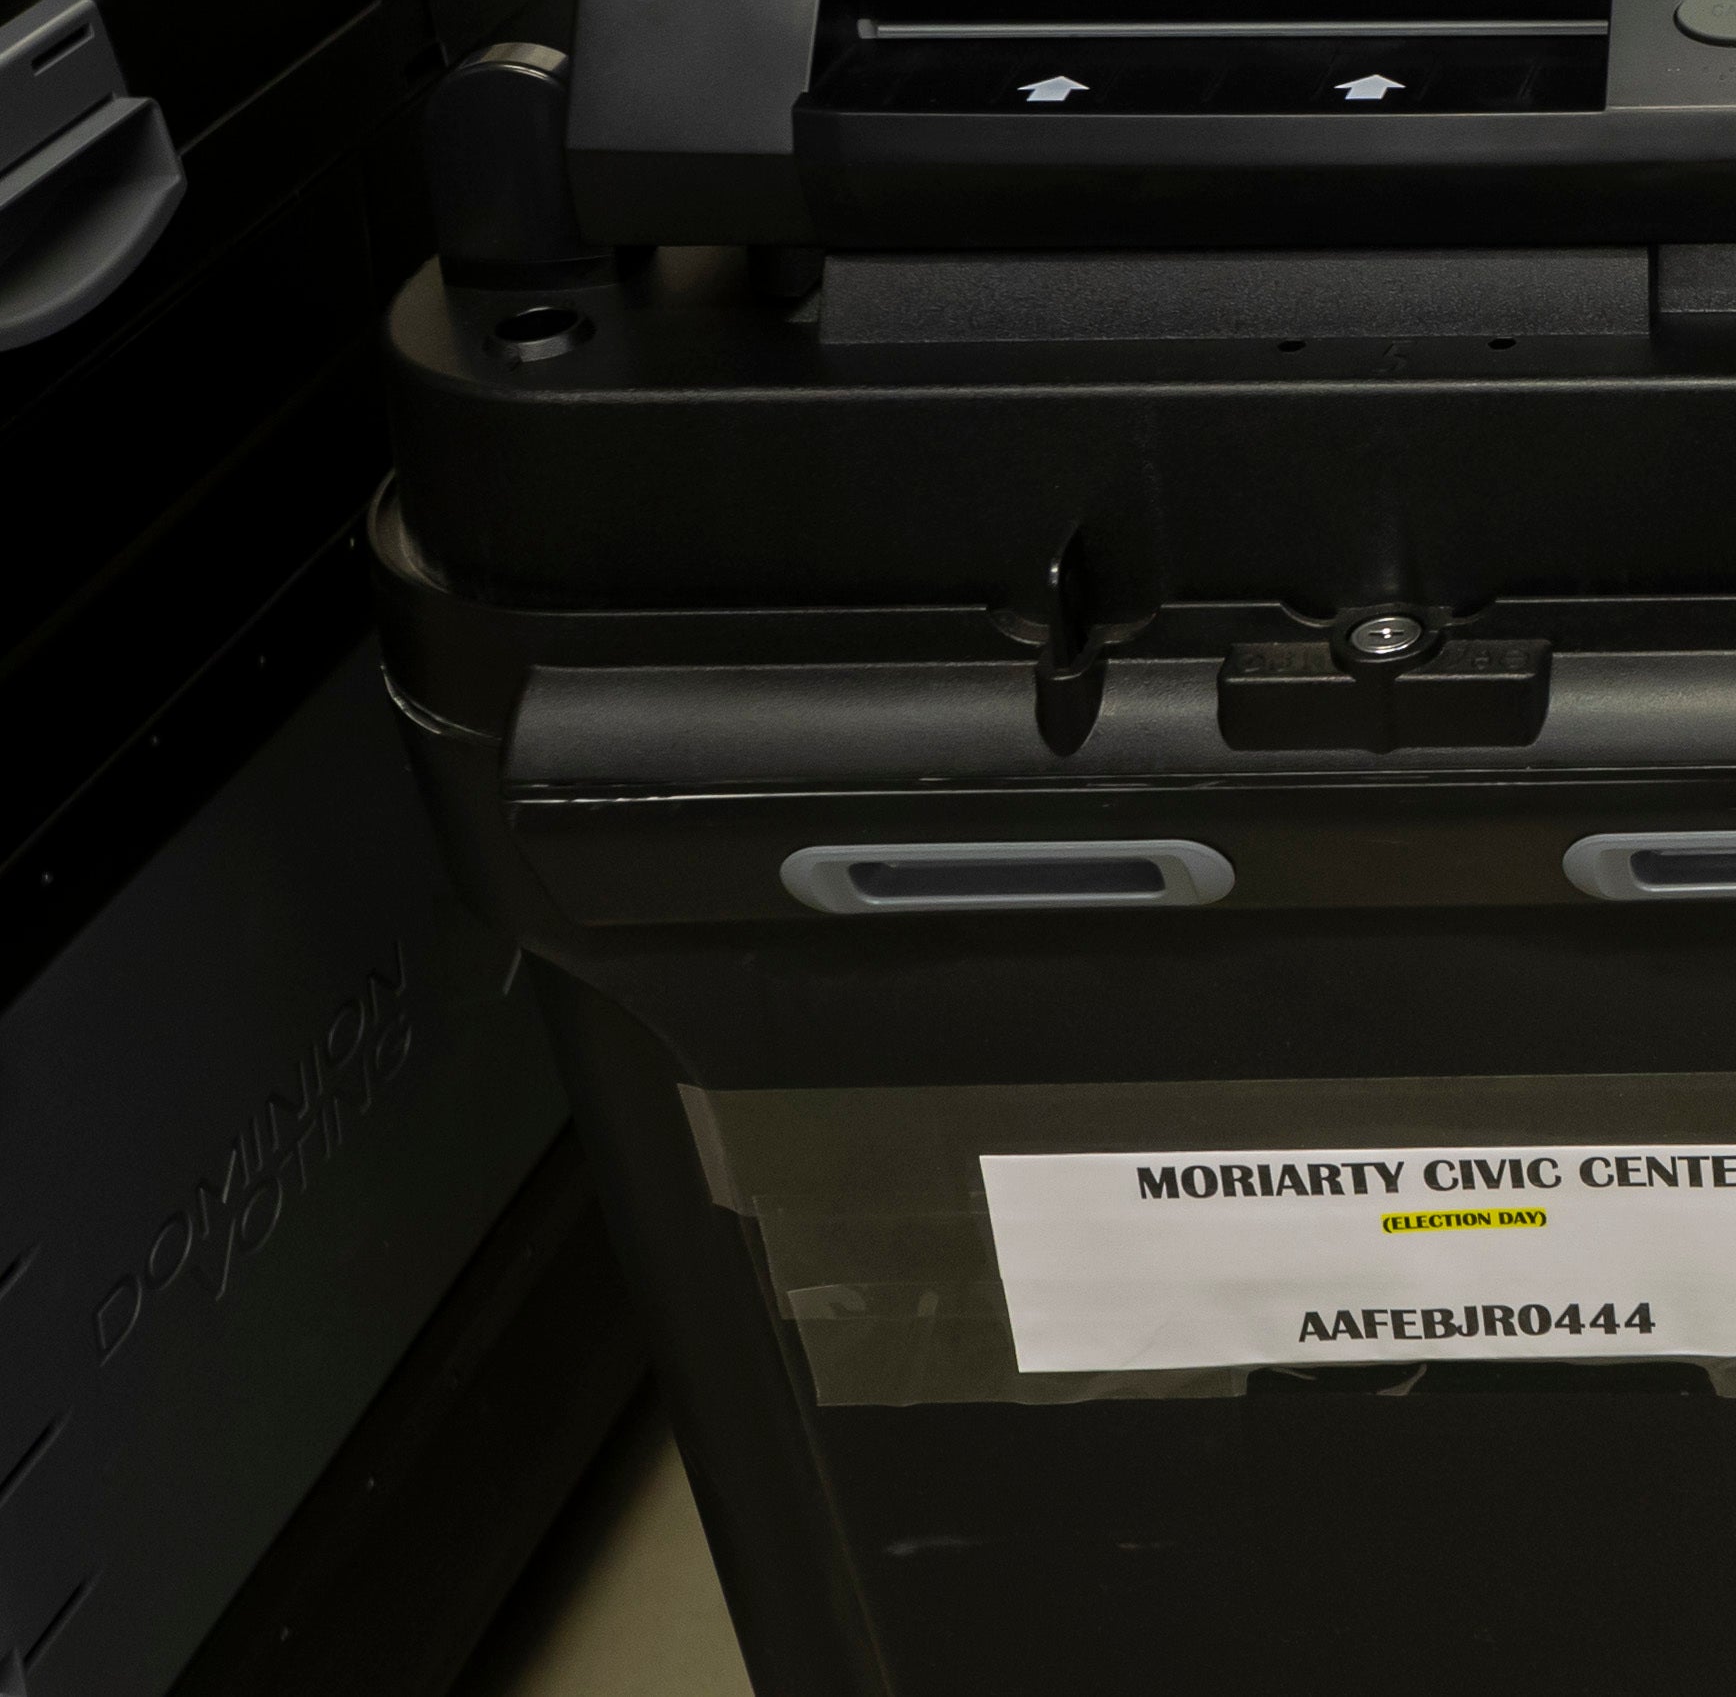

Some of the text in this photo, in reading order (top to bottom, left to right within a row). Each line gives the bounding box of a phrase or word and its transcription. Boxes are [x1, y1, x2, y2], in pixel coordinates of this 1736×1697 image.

[93, 939, 407, 1367] DOMINION
[190, 1012, 413, 1302] VOTING
[1138, 1161, 1404, 1199] MORIARTY
[1423, 1157, 1562, 1191] CIVIC
[1382, 1211, 1547, 1234] (ELECTION DAY)
[1298, 1302, 1657, 1343] AAFEBJR0444
